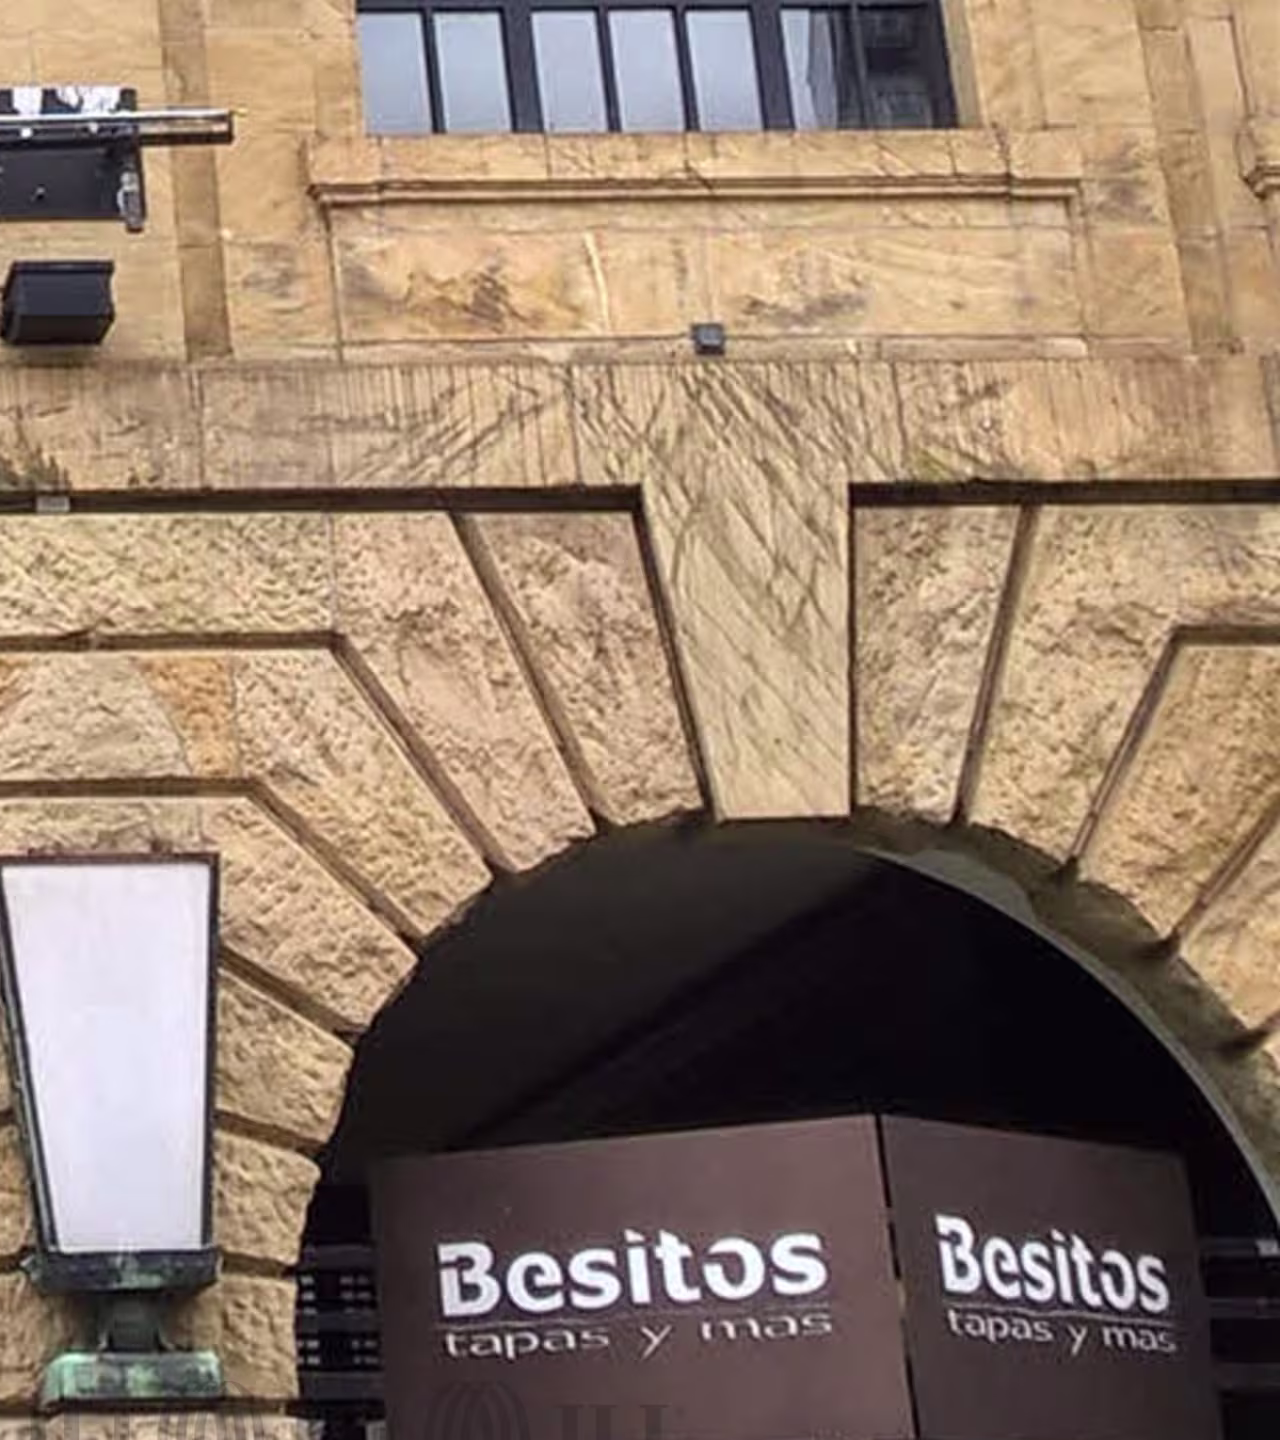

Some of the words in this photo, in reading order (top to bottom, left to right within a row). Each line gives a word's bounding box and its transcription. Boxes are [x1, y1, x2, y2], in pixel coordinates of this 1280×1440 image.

[437, 1228, 830, 1318] Besitos
[934, 1213, 1170, 1313] Besitos
[444, 1326, 611, 1361] tapas
[639, 1323, 673, 1359] y
[699, 1312, 833, 1342] mas
[947, 1307, 1054, 1343] tapas
[1067, 1325, 1088, 1356] y
[1101, 1324, 1178, 1353] mas
